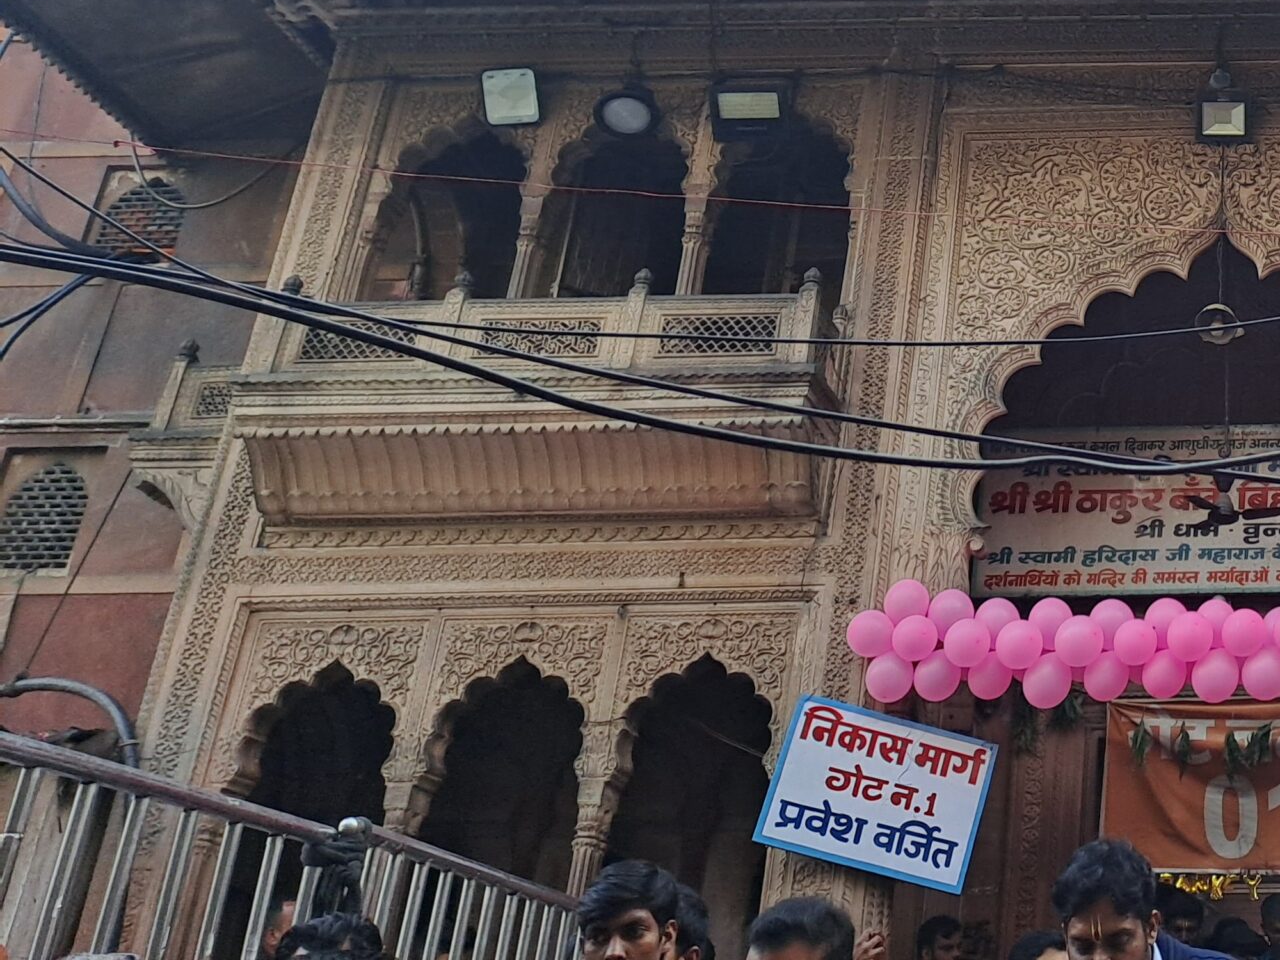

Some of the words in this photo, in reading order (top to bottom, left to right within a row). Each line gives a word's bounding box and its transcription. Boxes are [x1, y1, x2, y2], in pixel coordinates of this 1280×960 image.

[989, 481, 1030, 514] श्री
[1032, 480, 1072, 513] श्री
[1075, 488, 1165, 524] ठाकुर
[1135, 518, 1165, 538] श्री
[988, 546, 1013, 565] श्री
[1018, 546, 1076, 564] स्वामी
[1081, 545, 1159, 567] हरिदास
[1165, 543, 1191, 561] जी
[1198, 547, 1265, 564] महाराज
[984, 569, 1059, 590] दर्शनार्थियों
[1063, 569, 1081, 586] को
[1086, 568, 1125, 587] मन्दिर
[1131, 567, 1147, 585] की
[1206, 566, 1270, 585] मर्यादाओं
[800, 706, 913, 765] निकास
[914, 741, 986, 785] मार्ग
[825, 764, 888, 801] गेट
[774, 799, 868, 844] प्रवेश
[873, 820, 958, 869] वर्जित
